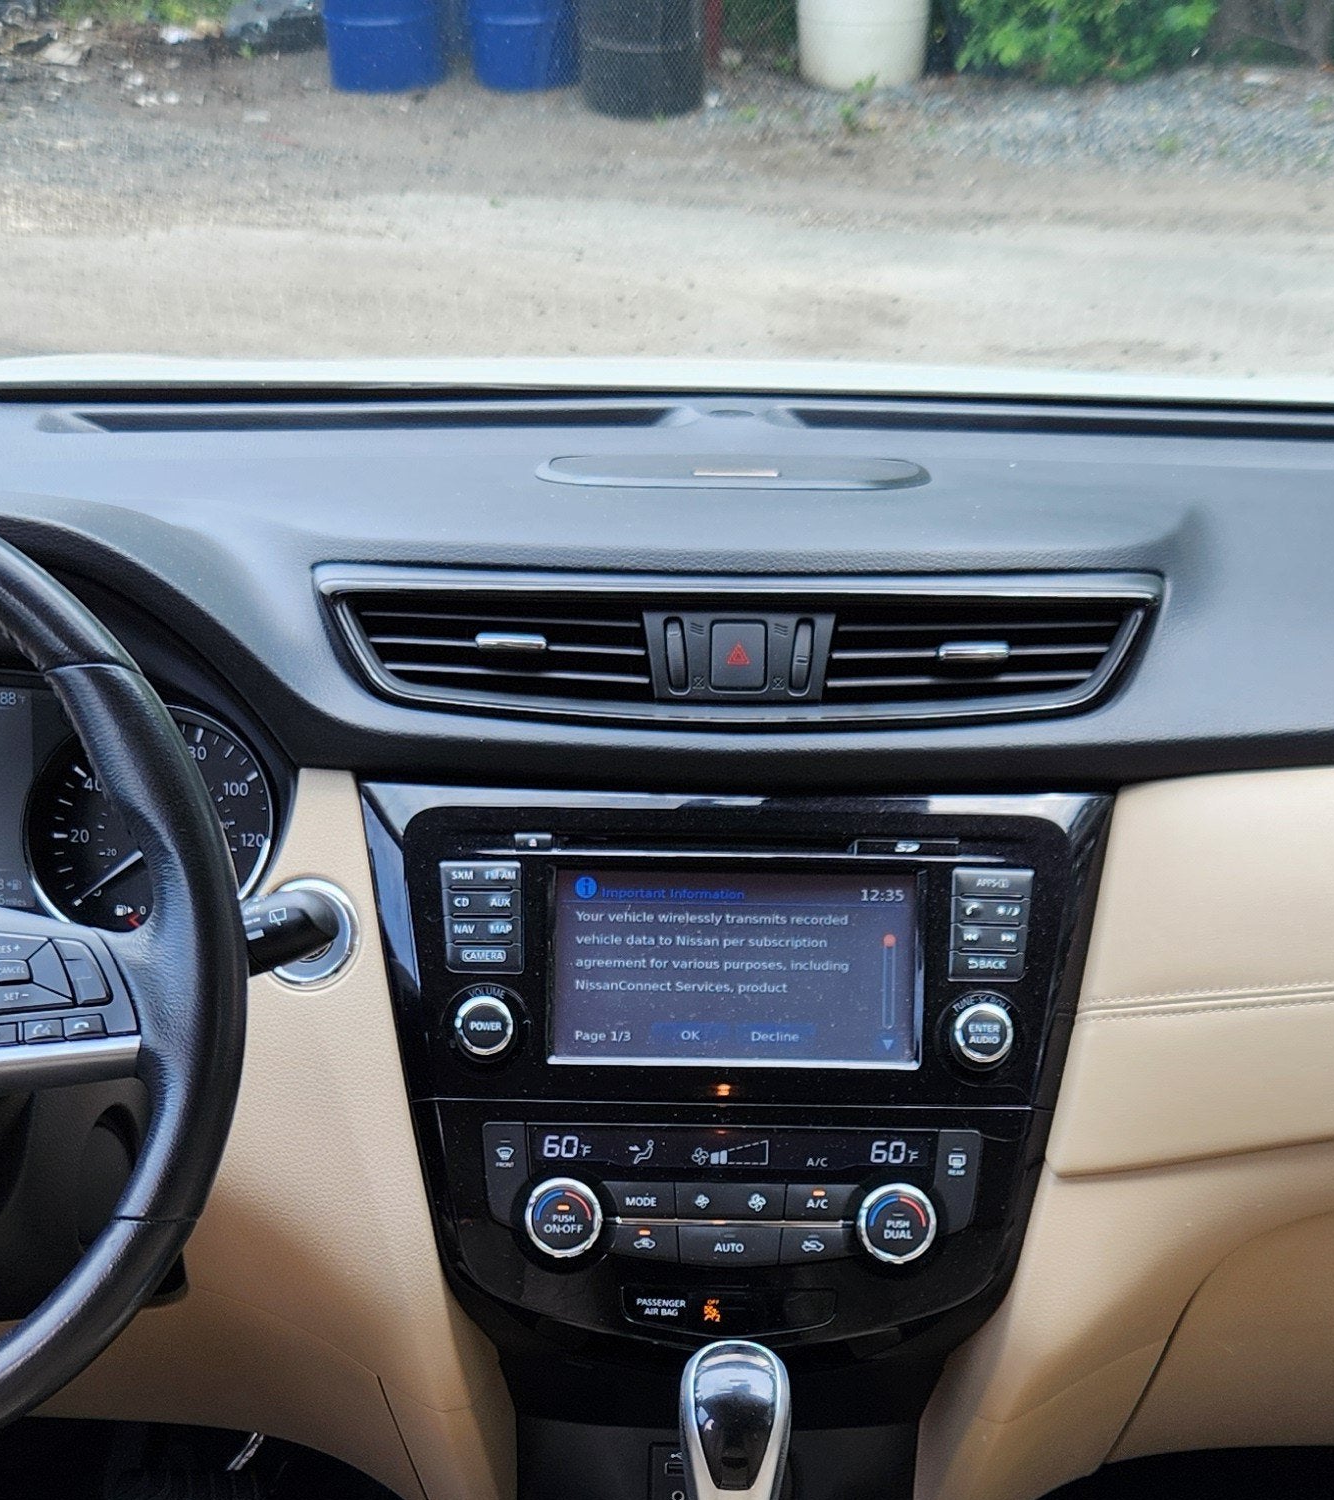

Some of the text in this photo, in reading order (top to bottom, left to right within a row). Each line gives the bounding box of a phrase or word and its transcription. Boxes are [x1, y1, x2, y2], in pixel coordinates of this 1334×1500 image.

[223, 781, 249, 796] 100
[70, 829, 89, 843] 20
[241, 833, 264, 848] 120
[451, 869, 474, 880] SXM
[601, 888, 744, 900] Important Information
[860, 889, 905, 902] 12:35
[453, 898, 470, 907] CD
[489, 898, 511, 908] AUX
[575, 911, 849, 926] Your vehicle wirelessly transmits recorded
[453, 924, 475, 934] NAV
[488, 924, 512, 934] MAP
[575, 934, 827, 949] vehicle data to Nissan per subscription
[464, 951, 504, 961] CAMERA
[575, 958, 850, 974] agreement for various purposes, including
[979, 960, 1008, 970] BACK
[575, 979, 788, 995] NissanConnect Services, product
[3, 993, 19, 1001] SET
[469, 1021, 502, 1032] POWER
[968, 1023, 1001, 1034] ENTER
[575, 1030, 631, 1043] Page 1/3
[681, 1030, 701, 1041] OK
[751, 1031, 800, 1042] Decline
[969, 1034, 1001, 1045] AUDIO
[806, 1157, 828, 1168] A/C
[625, 1196, 657, 1207] MODE
[806, 1199, 828, 1210] A/C
[552, 1213, 576, 1223] PUSH
[886, 1220, 909, 1229] PUSH
[884, 1229, 913, 1240] DUAL
[714, 1243, 744, 1253] AUTO
[636, 1298, 686, 1308] PASSENGER
[644, 1308, 678, 1317] AIR BAG
